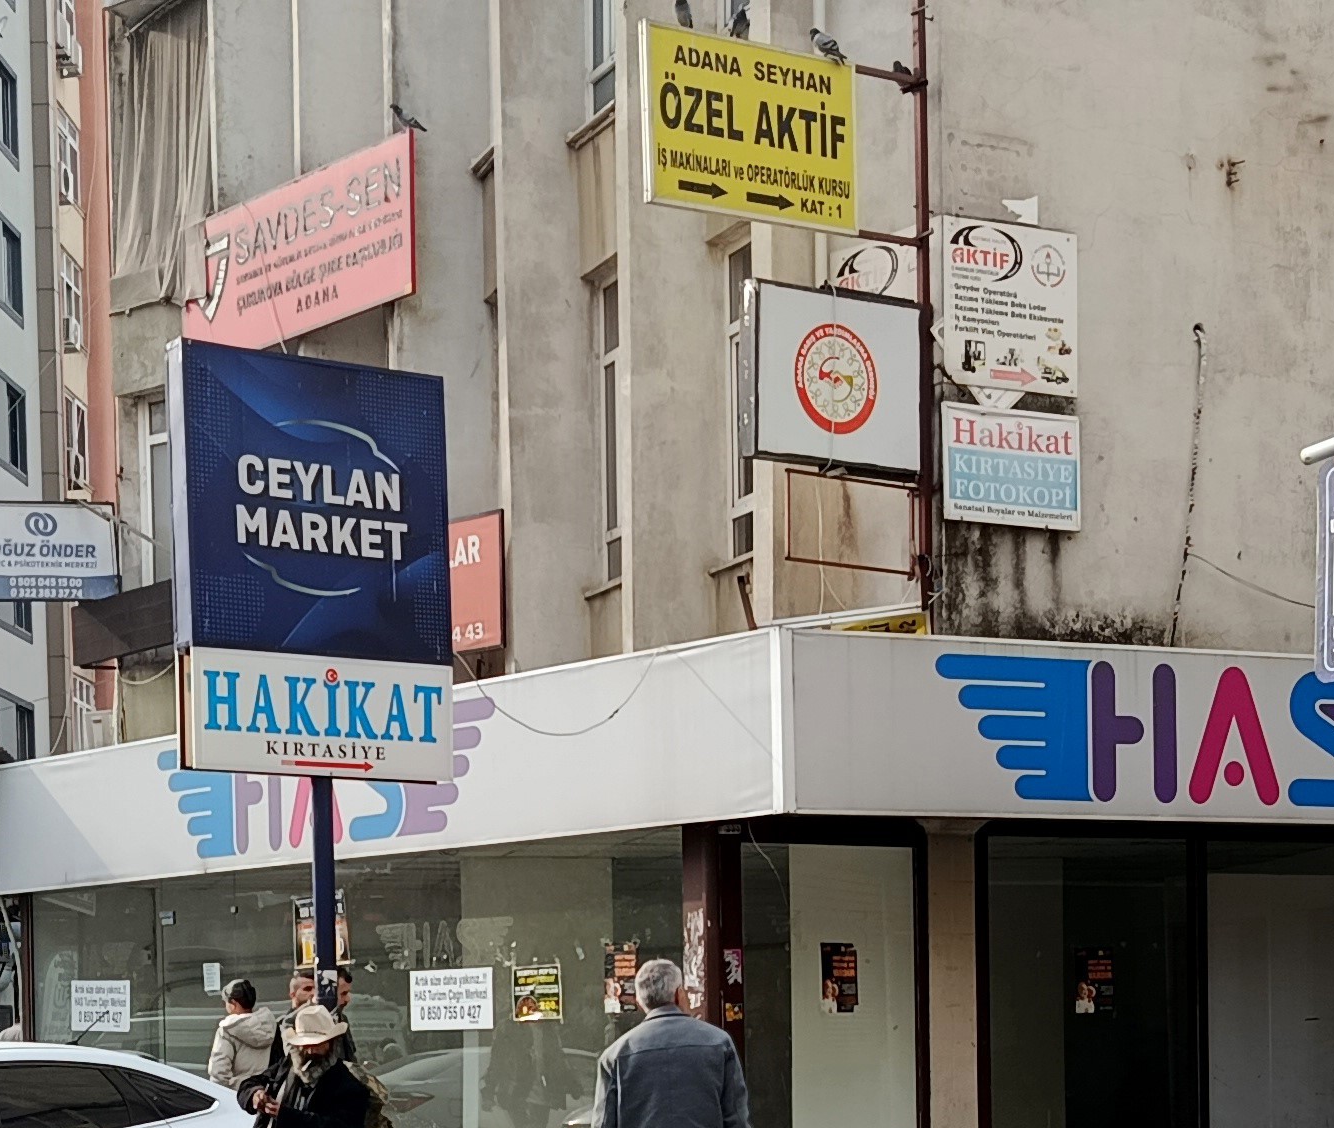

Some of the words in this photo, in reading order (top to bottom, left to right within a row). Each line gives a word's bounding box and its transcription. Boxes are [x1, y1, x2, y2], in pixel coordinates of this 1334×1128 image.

[674, 45, 742, 77] ADANA
[754, 61, 831, 95] SEYHAN
[660, 71, 744, 141] ÖZEL
[754, 101, 845, 160] AKTİF
[658, 143, 667, 171] İŞ
[670, 149, 731, 178] MAKİNALARI
[733, 166, 744, 180] ve
[746, 163, 816, 193] OPERATÖRLÜK
[818, 177, 850, 199] KURSU
[235, 157, 402, 266] SAVDES-SEN
[801, 198, 824, 215] KAT
[836, 204, 842, 219] 1
[952, 247, 1010, 270] AKTİF
[296, 285, 339, 313] ADANA
[953, 417, 1073, 455] Hakikat
[237, 453, 401, 512] CEYLAN
[954, 453, 1073, 483] KIRTASİYE
[955, 479, 1072, 508] FOTOKOPİ
[235, 503, 408, 561] MARKET
[40, 540, 96, 558] ÖNDER
[449, 534, 480, 569] AR
[14, 559, 63, 568] PSİKOTEKNİK
[64, 561, 98, 569] MERKEZİ
[57, 578, 68, 587] 15
[69, 578, 82, 587] 00
[465, 622, 484, 640] 43
[202, 668, 443, 744] HAKİKAT
[265, 740, 386, 760] KIRTASİYE
[420, 1006, 425, 1020] 0
[460, 1006, 465, 1019] 0
[467, 1005, 481, 1019] 427
